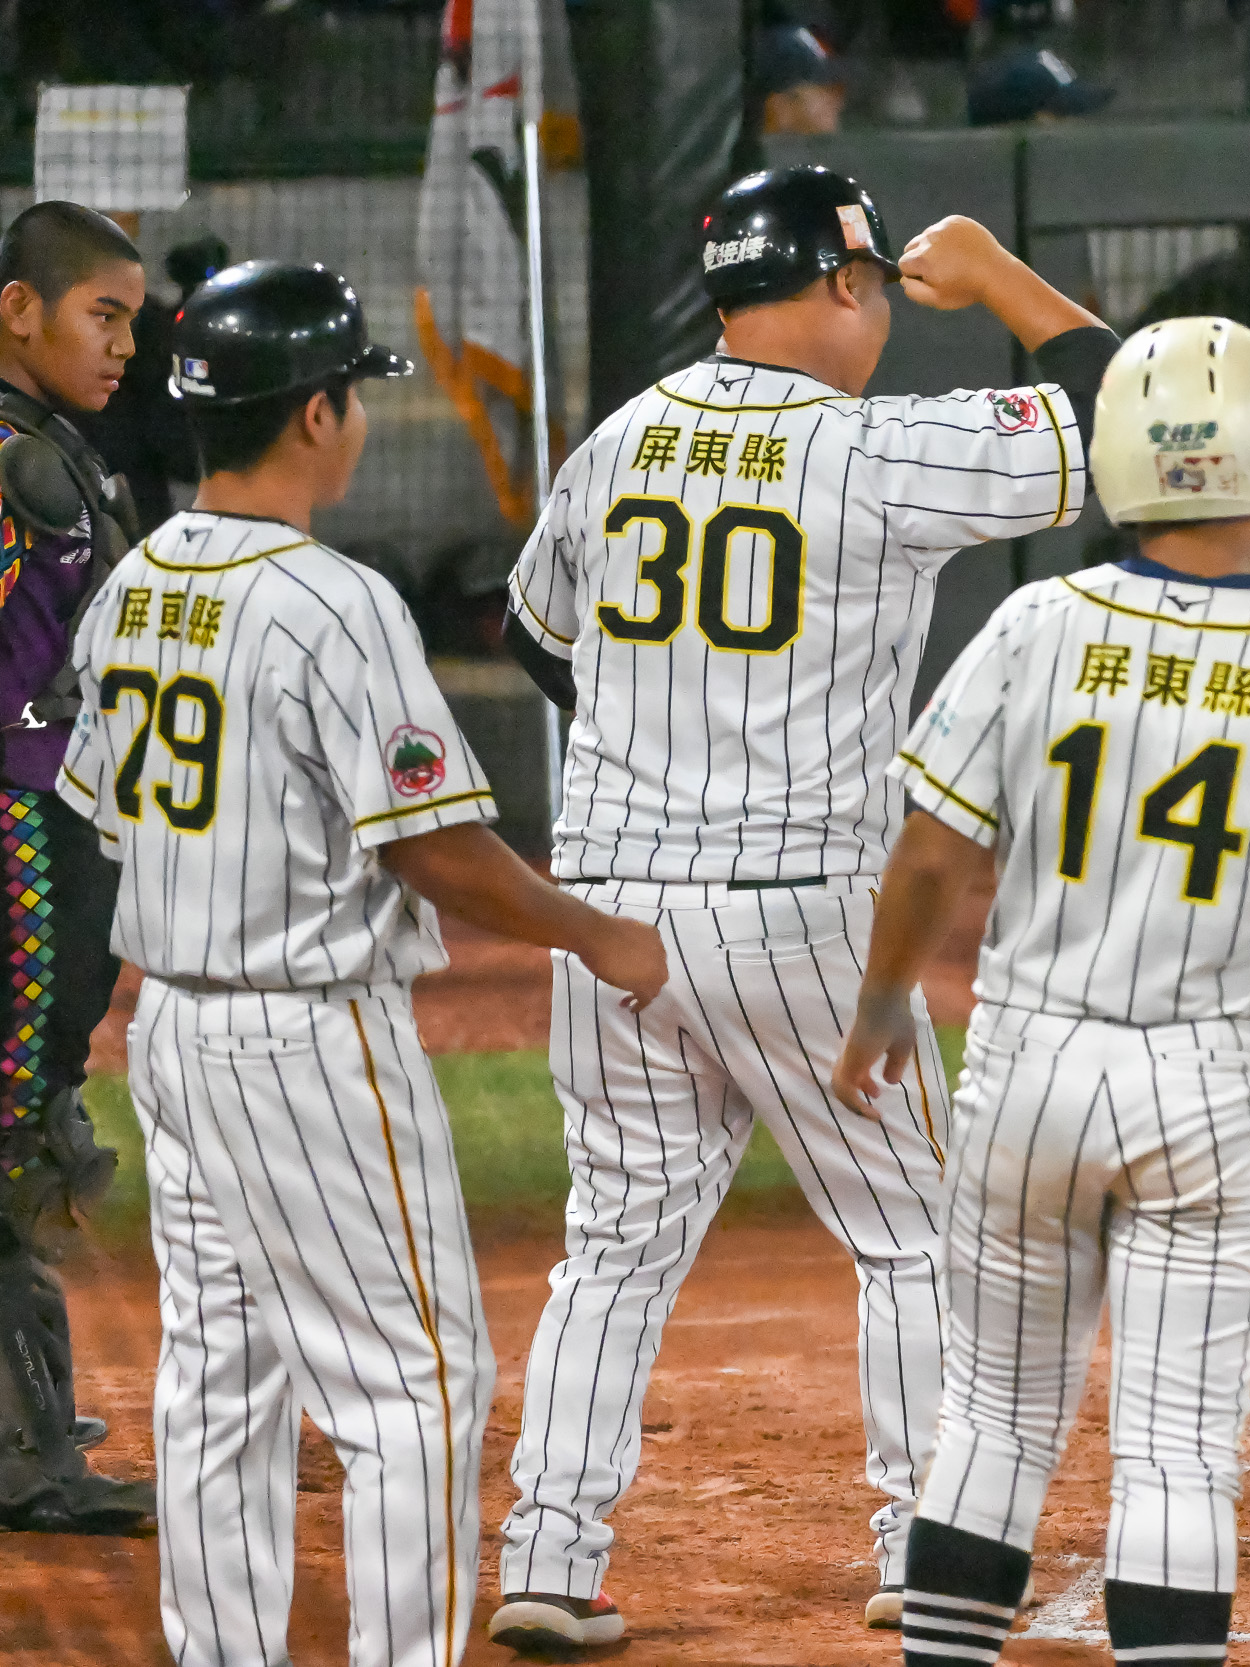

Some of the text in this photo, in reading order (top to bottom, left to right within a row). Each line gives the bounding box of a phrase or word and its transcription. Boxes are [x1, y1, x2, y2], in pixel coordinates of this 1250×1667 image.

[630, 424, 788, 483] 屏東縣
[594, 493, 808, 656] 30
[100, 662, 225, 835] 29
[1047, 718, 1249, 906] 14
